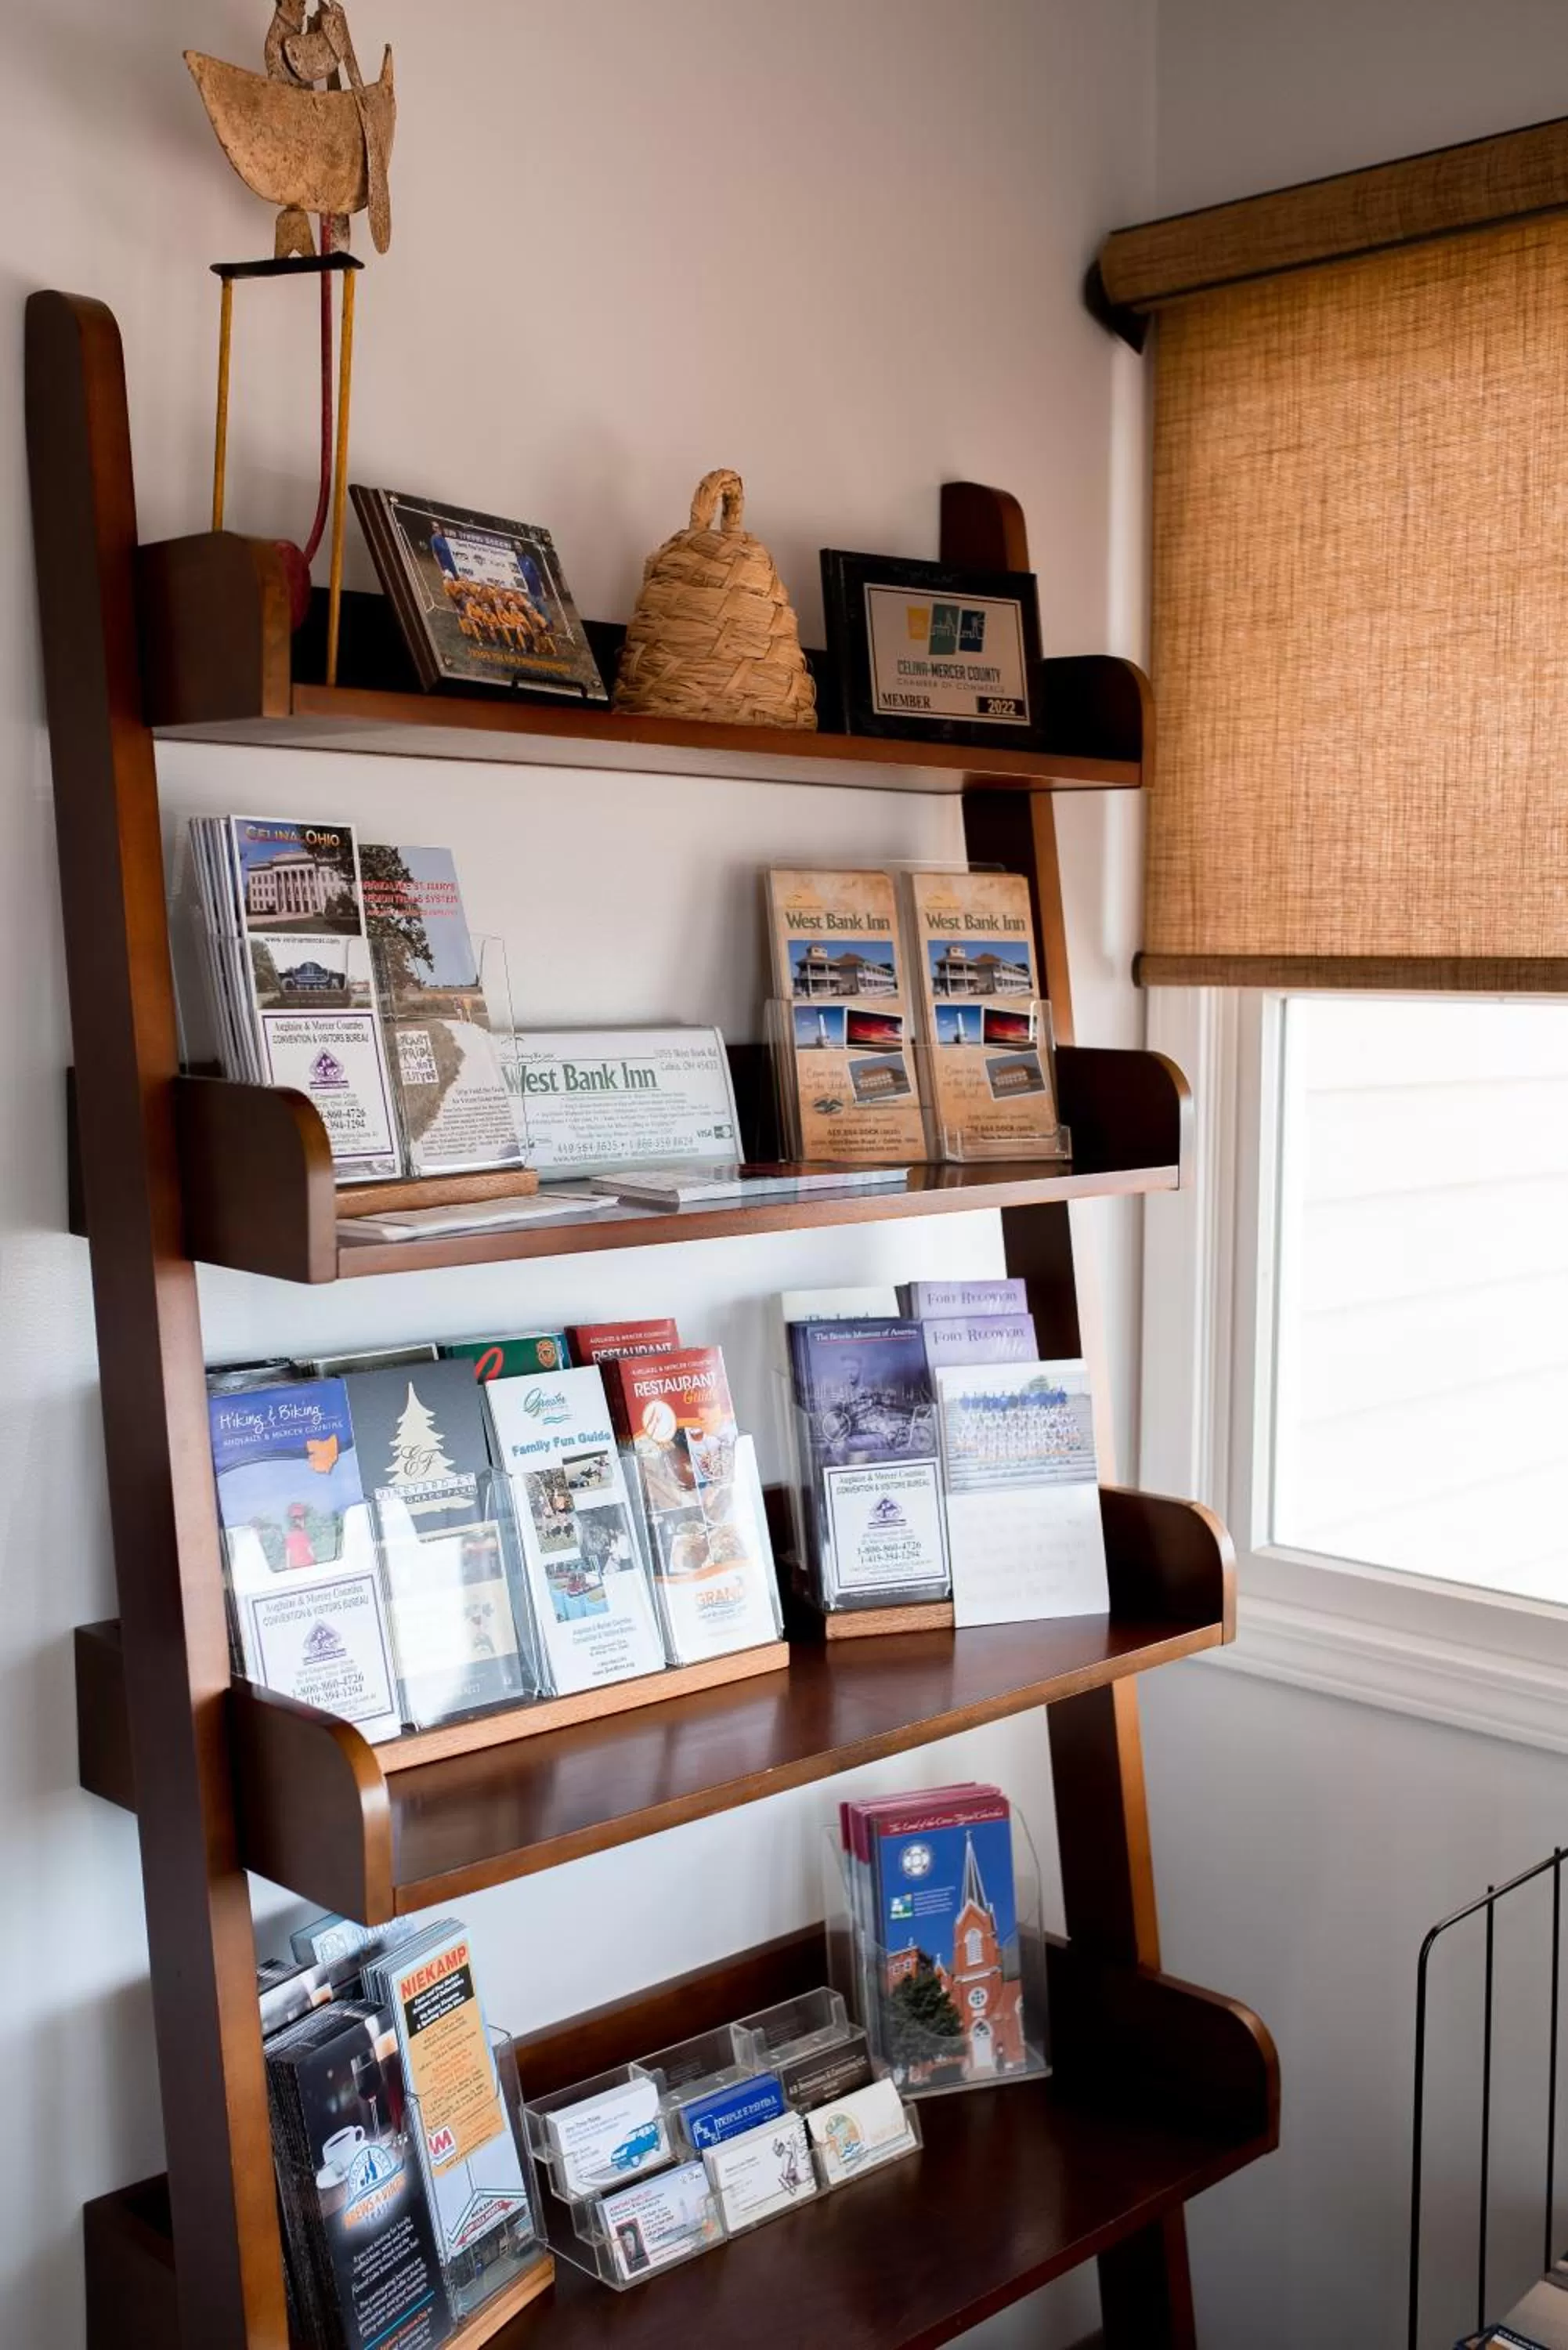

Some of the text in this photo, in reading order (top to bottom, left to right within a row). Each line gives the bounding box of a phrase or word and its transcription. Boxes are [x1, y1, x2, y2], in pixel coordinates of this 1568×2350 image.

[898, 659, 1001, 683] CELINA-MERCER COUNTY
[897, 678, 938, 688] CHAMBER
[956, 682, 1004, 694] COMMERCE
[882, 693, 930, 708] MEMBER
[988, 699, 1016, 714] 2022
[785, 913, 891, 931] West Bank Inn
[926, 913, 1026, 931] West Bank Inn
[304, 1021, 310, 1030] &
[273, 1035, 311, 1044] CONVENTION
[501, 1061, 657, 1094] West Bank Inn
[696, 1129, 713, 1138] VISA
[927, 1293, 956, 1306] FORT
[933, 1331, 962, 1346] FORT
[634, 1372, 717, 1399] RESTAURANT
[220, 1412, 264, 1434] Hiking
[278, 1401, 325, 1425] Biking
[511, 1430, 612, 1457] Family Fun Guide
[298, 1596, 305, 1607] &
[262, 1611, 306, 1627] CONVENTION
[400, 1945, 466, 2000] NIEKAMP
